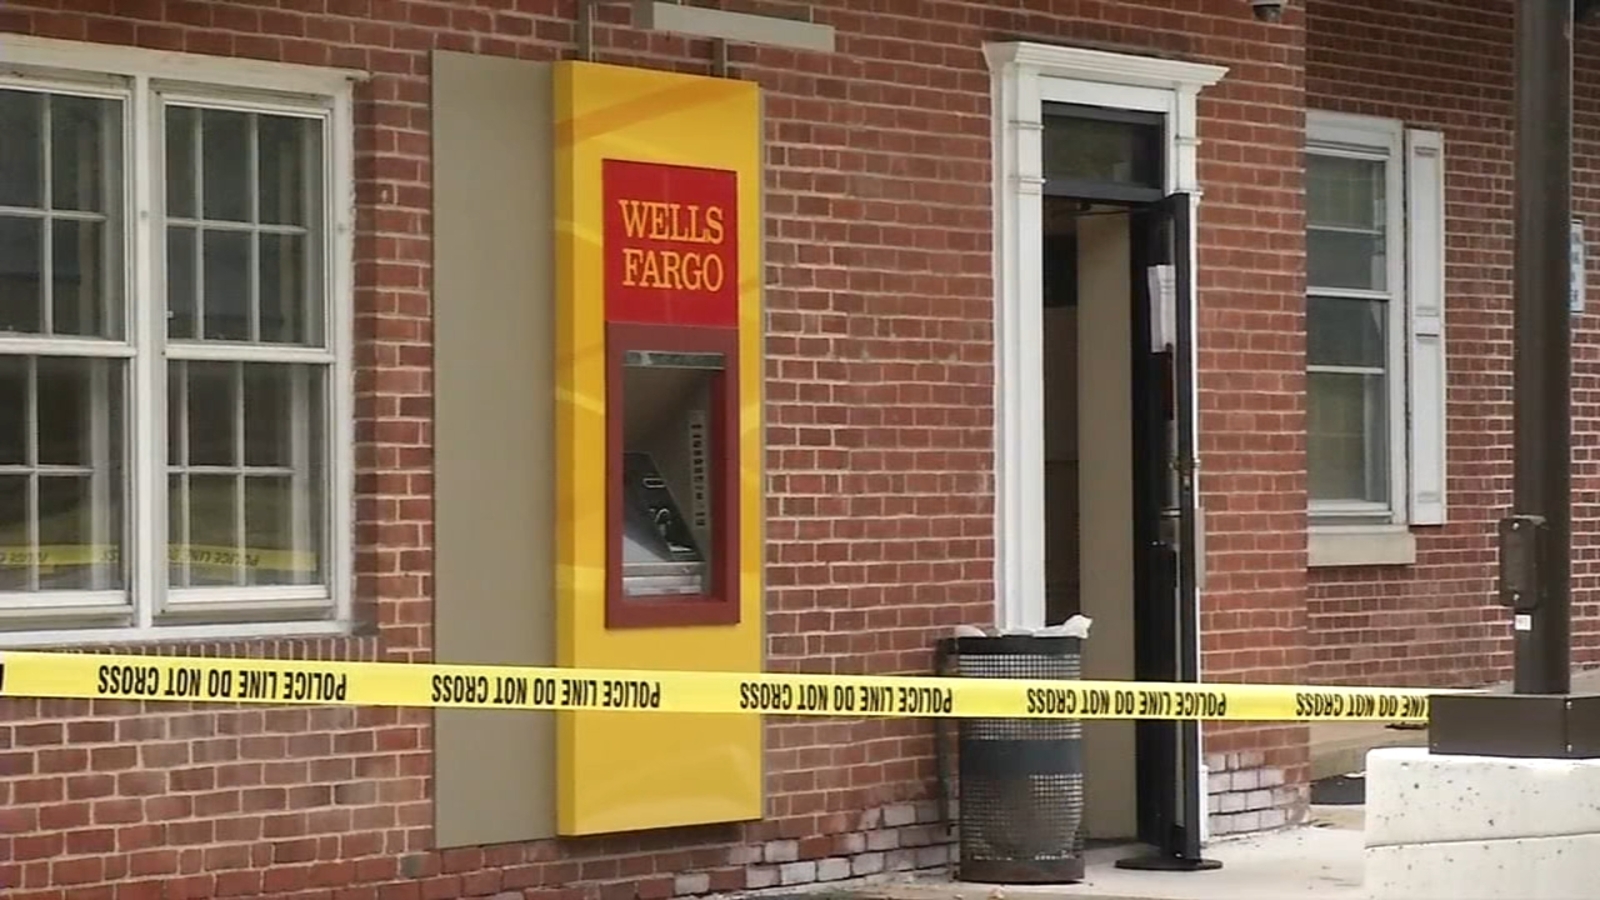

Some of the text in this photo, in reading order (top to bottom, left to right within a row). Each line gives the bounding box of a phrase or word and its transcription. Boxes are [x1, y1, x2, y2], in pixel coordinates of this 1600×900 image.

[618, 199, 724, 244] WELLS
[622, 248, 724, 292] FARGO
[97, 665, 347, 701] POLICE LINE DO NOT CROSS
[431, 674, 661, 708] POLICE LINE DO NOT CROSS
[739, 682, 953, 713] POLICE LINE DO NOT CROSS
[1026, 688, 1227, 717] POLICE LINE DO NOT CROSS
[1295, 693, 1430, 718] INE DO NOT CROSS
